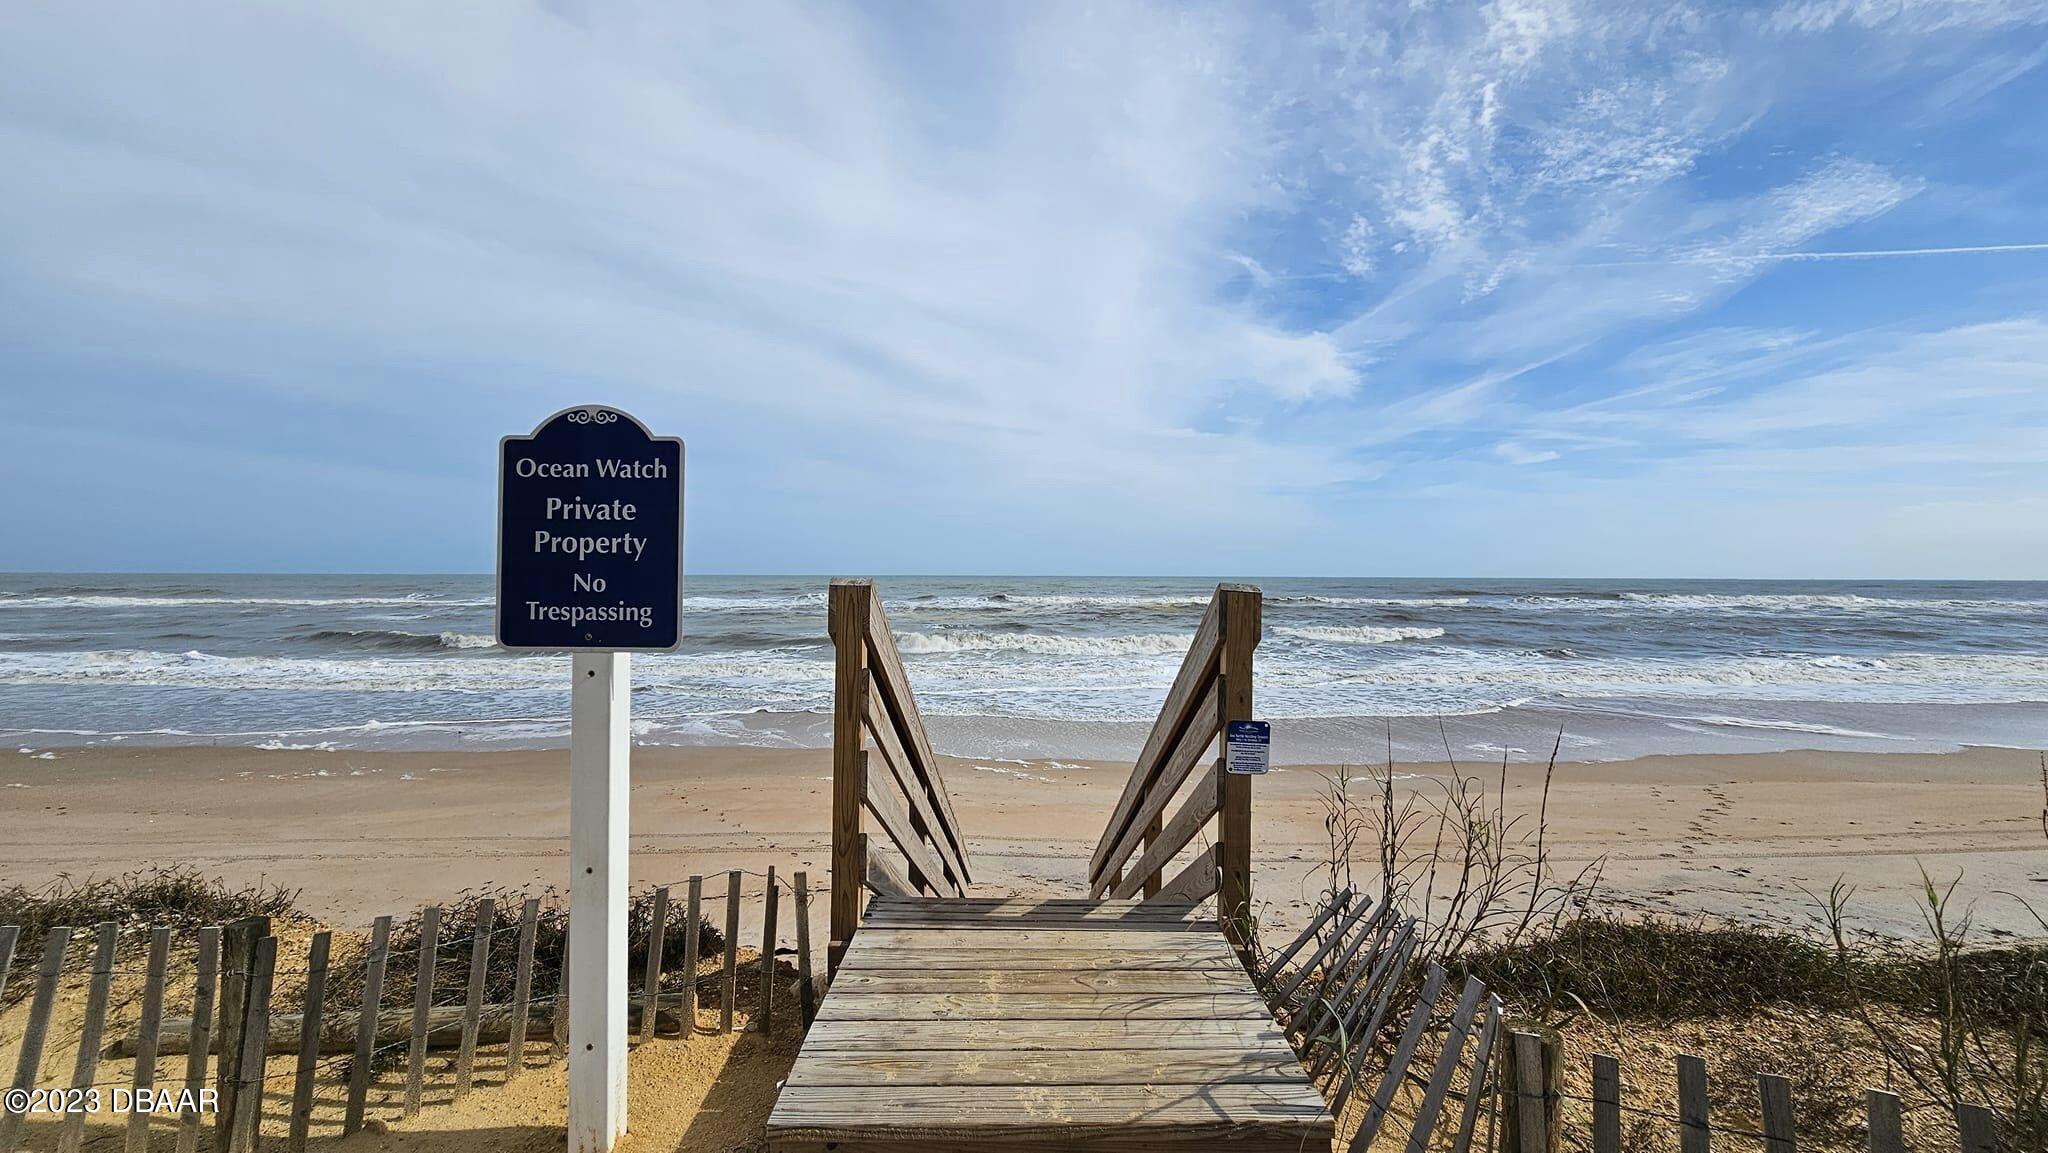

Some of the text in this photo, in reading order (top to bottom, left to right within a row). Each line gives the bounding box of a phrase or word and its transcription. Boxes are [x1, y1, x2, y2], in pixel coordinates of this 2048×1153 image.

[515, 458, 667, 479] Ocean Watch
[546, 495, 637, 521] Private
[534, 530, 647, 562] Property
[573, 573, 606, 593] No
[526, 600, 653, 628] Trespassing
